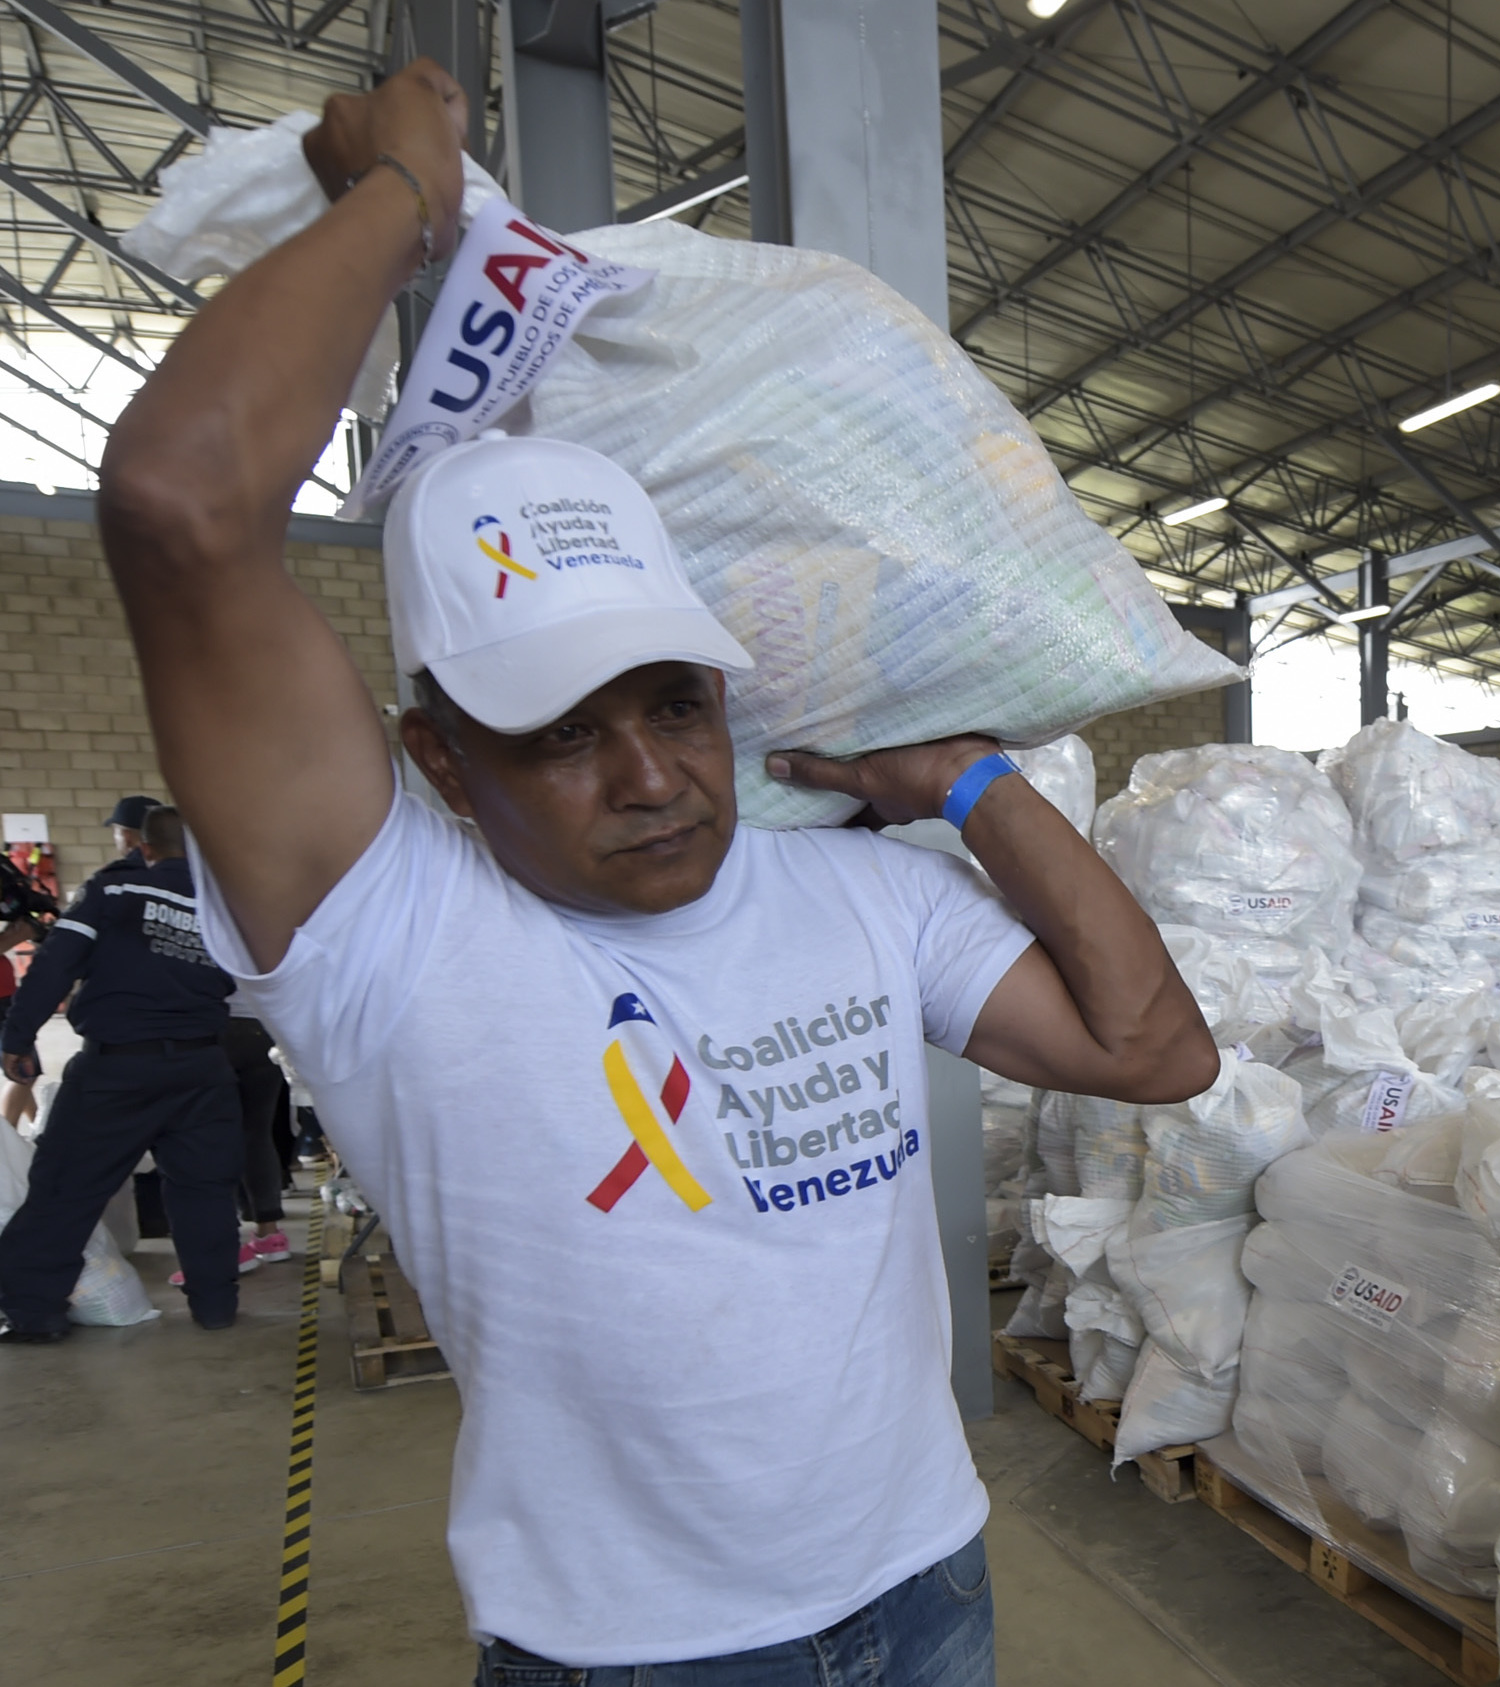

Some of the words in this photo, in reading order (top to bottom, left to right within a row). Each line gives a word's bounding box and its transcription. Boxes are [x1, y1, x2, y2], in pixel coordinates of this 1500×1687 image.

[497, 324, 540, 393] PUEBLO
[532, 294, 555, 323] DE
[545, 263, 578, 295] LOS
[554, 302, 577, 330] DE
[597, 520, 609, 534] y
[536, 536, 621, 556] Libertad
[545, 553, 646, 570] Venezuela
[1247, 896, 1292, 909] USAID
[696, 993, 892, 1072] Coalición
[716, 1061, 862, 1127] Ayuda
[862, 1049, 891, 1091] y
[1354, 1278, 1403, 1314] USAID
